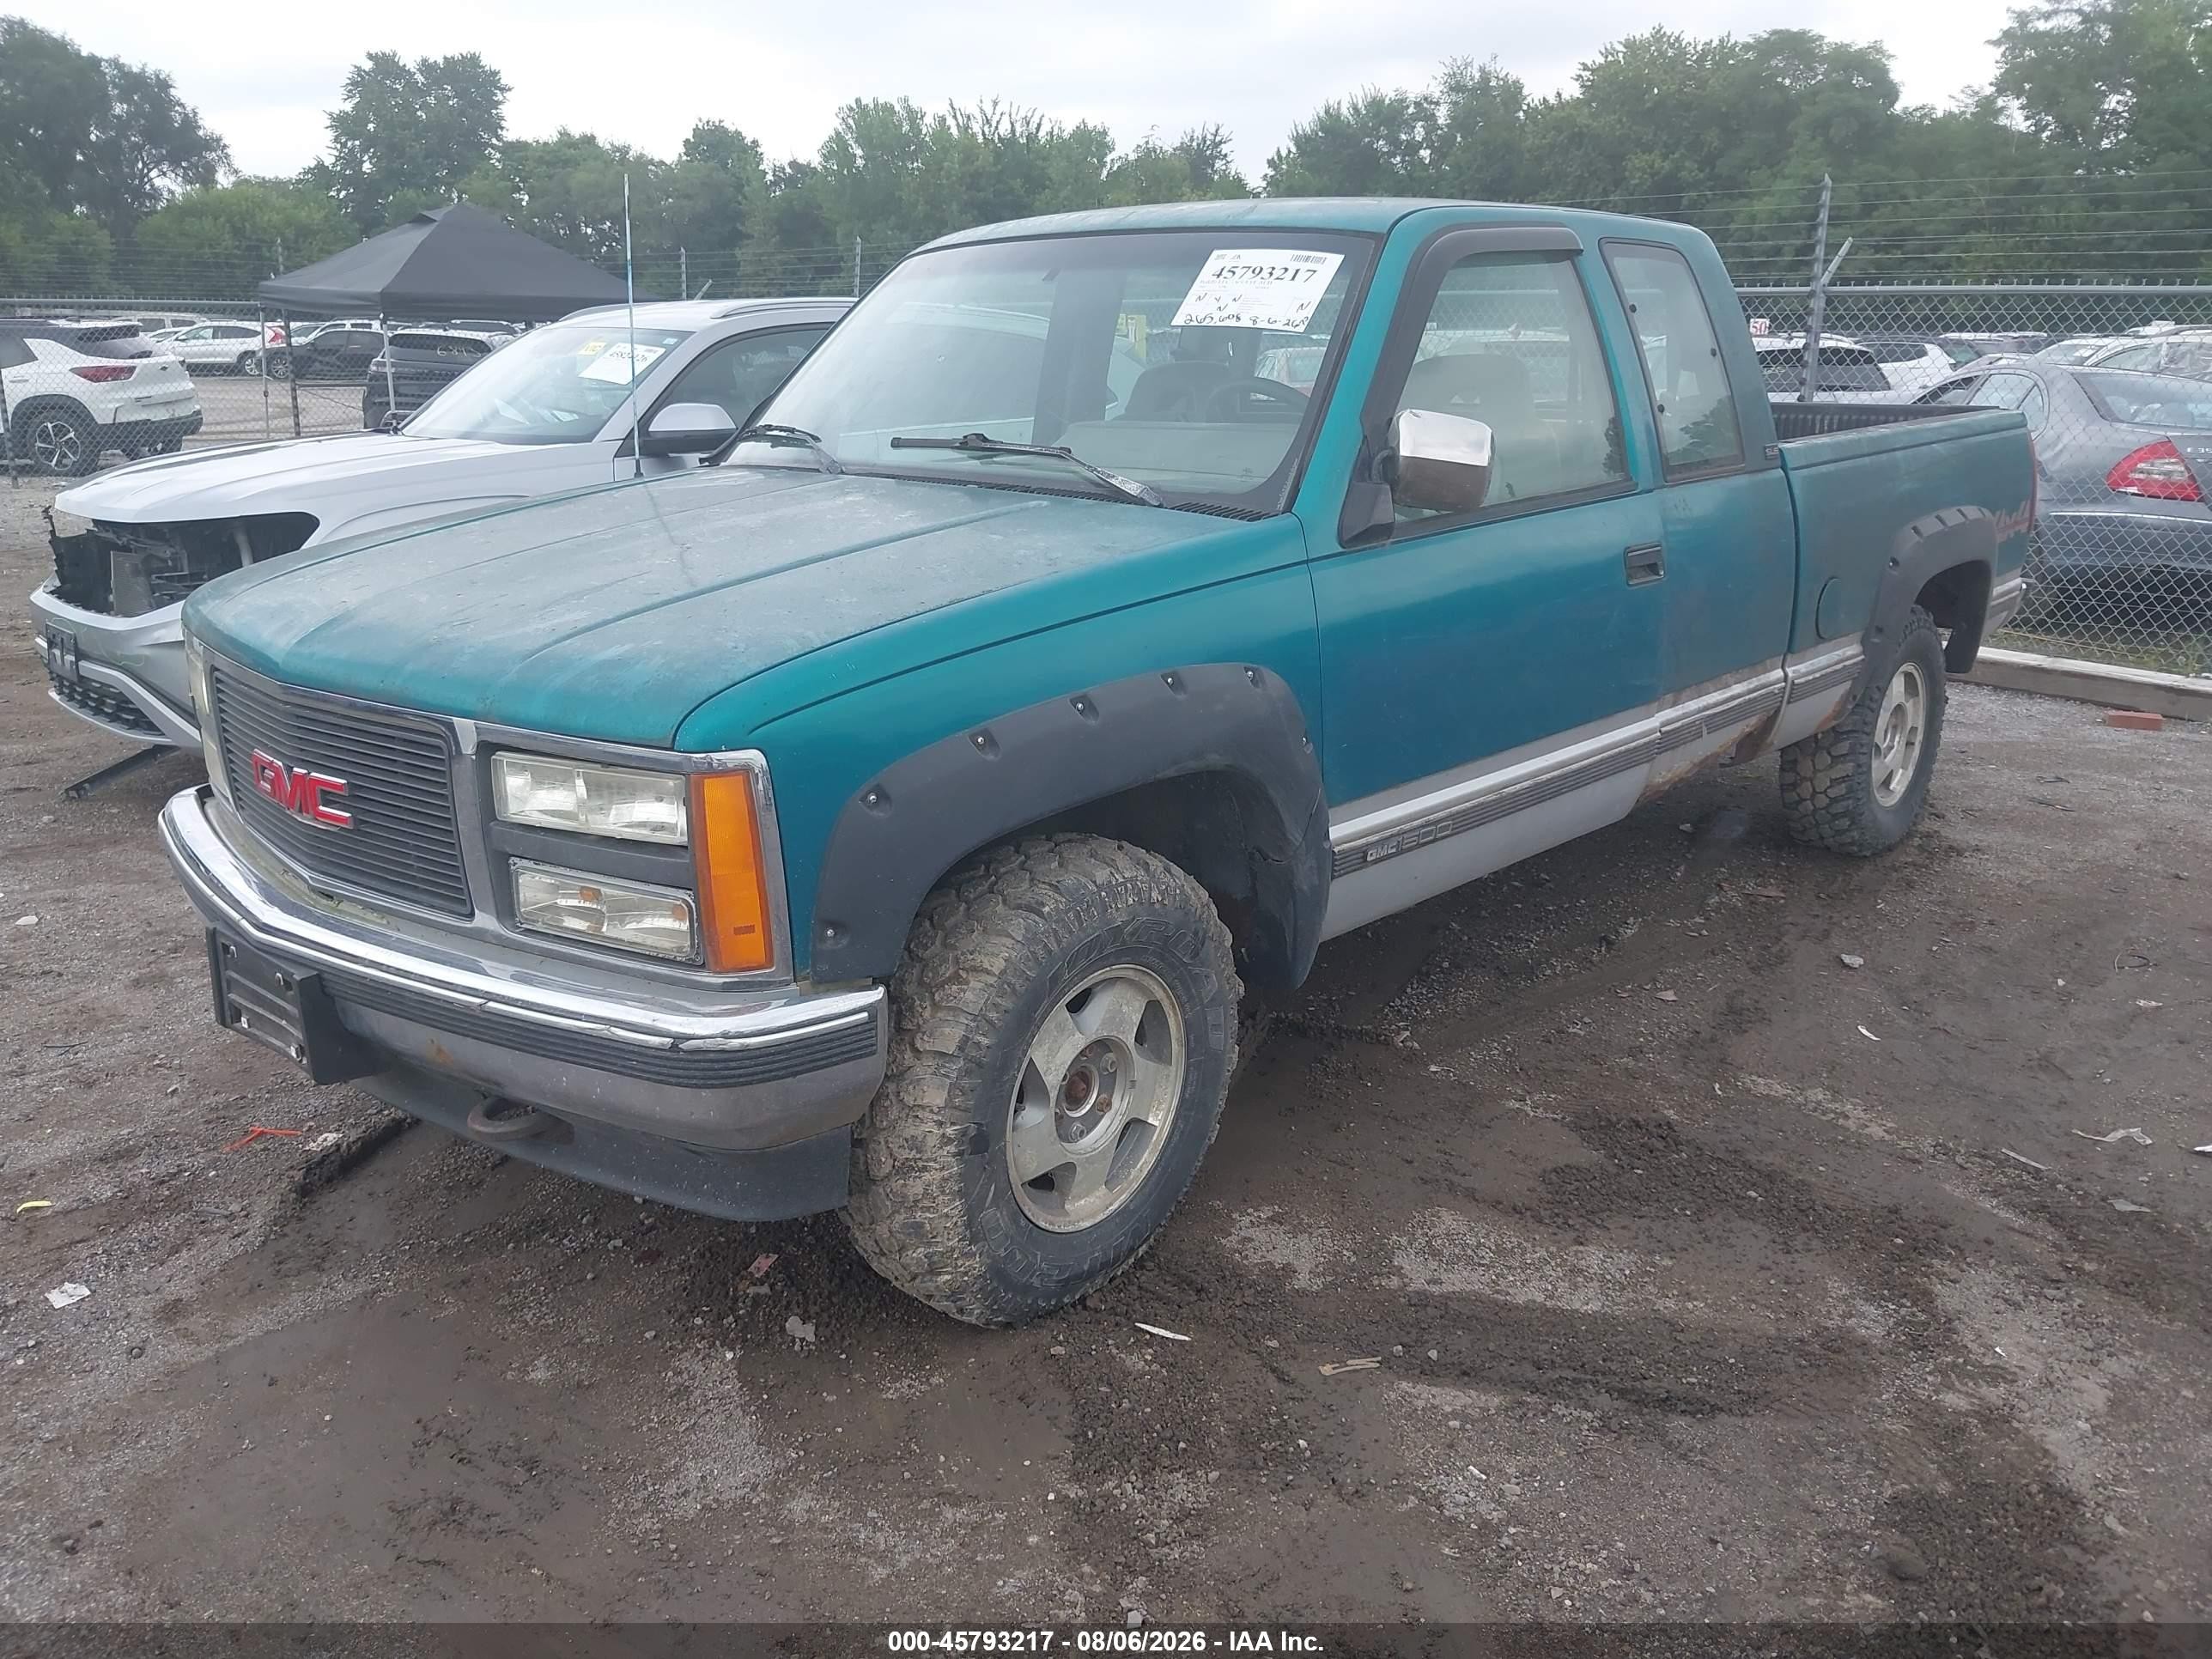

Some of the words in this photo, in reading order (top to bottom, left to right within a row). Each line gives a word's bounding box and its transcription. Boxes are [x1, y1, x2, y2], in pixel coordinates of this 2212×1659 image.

[1212, 265, 1317, 283] 45793217
[1752, 320, 1766, 333] 50
[252, 748, 353, 830] GMC
